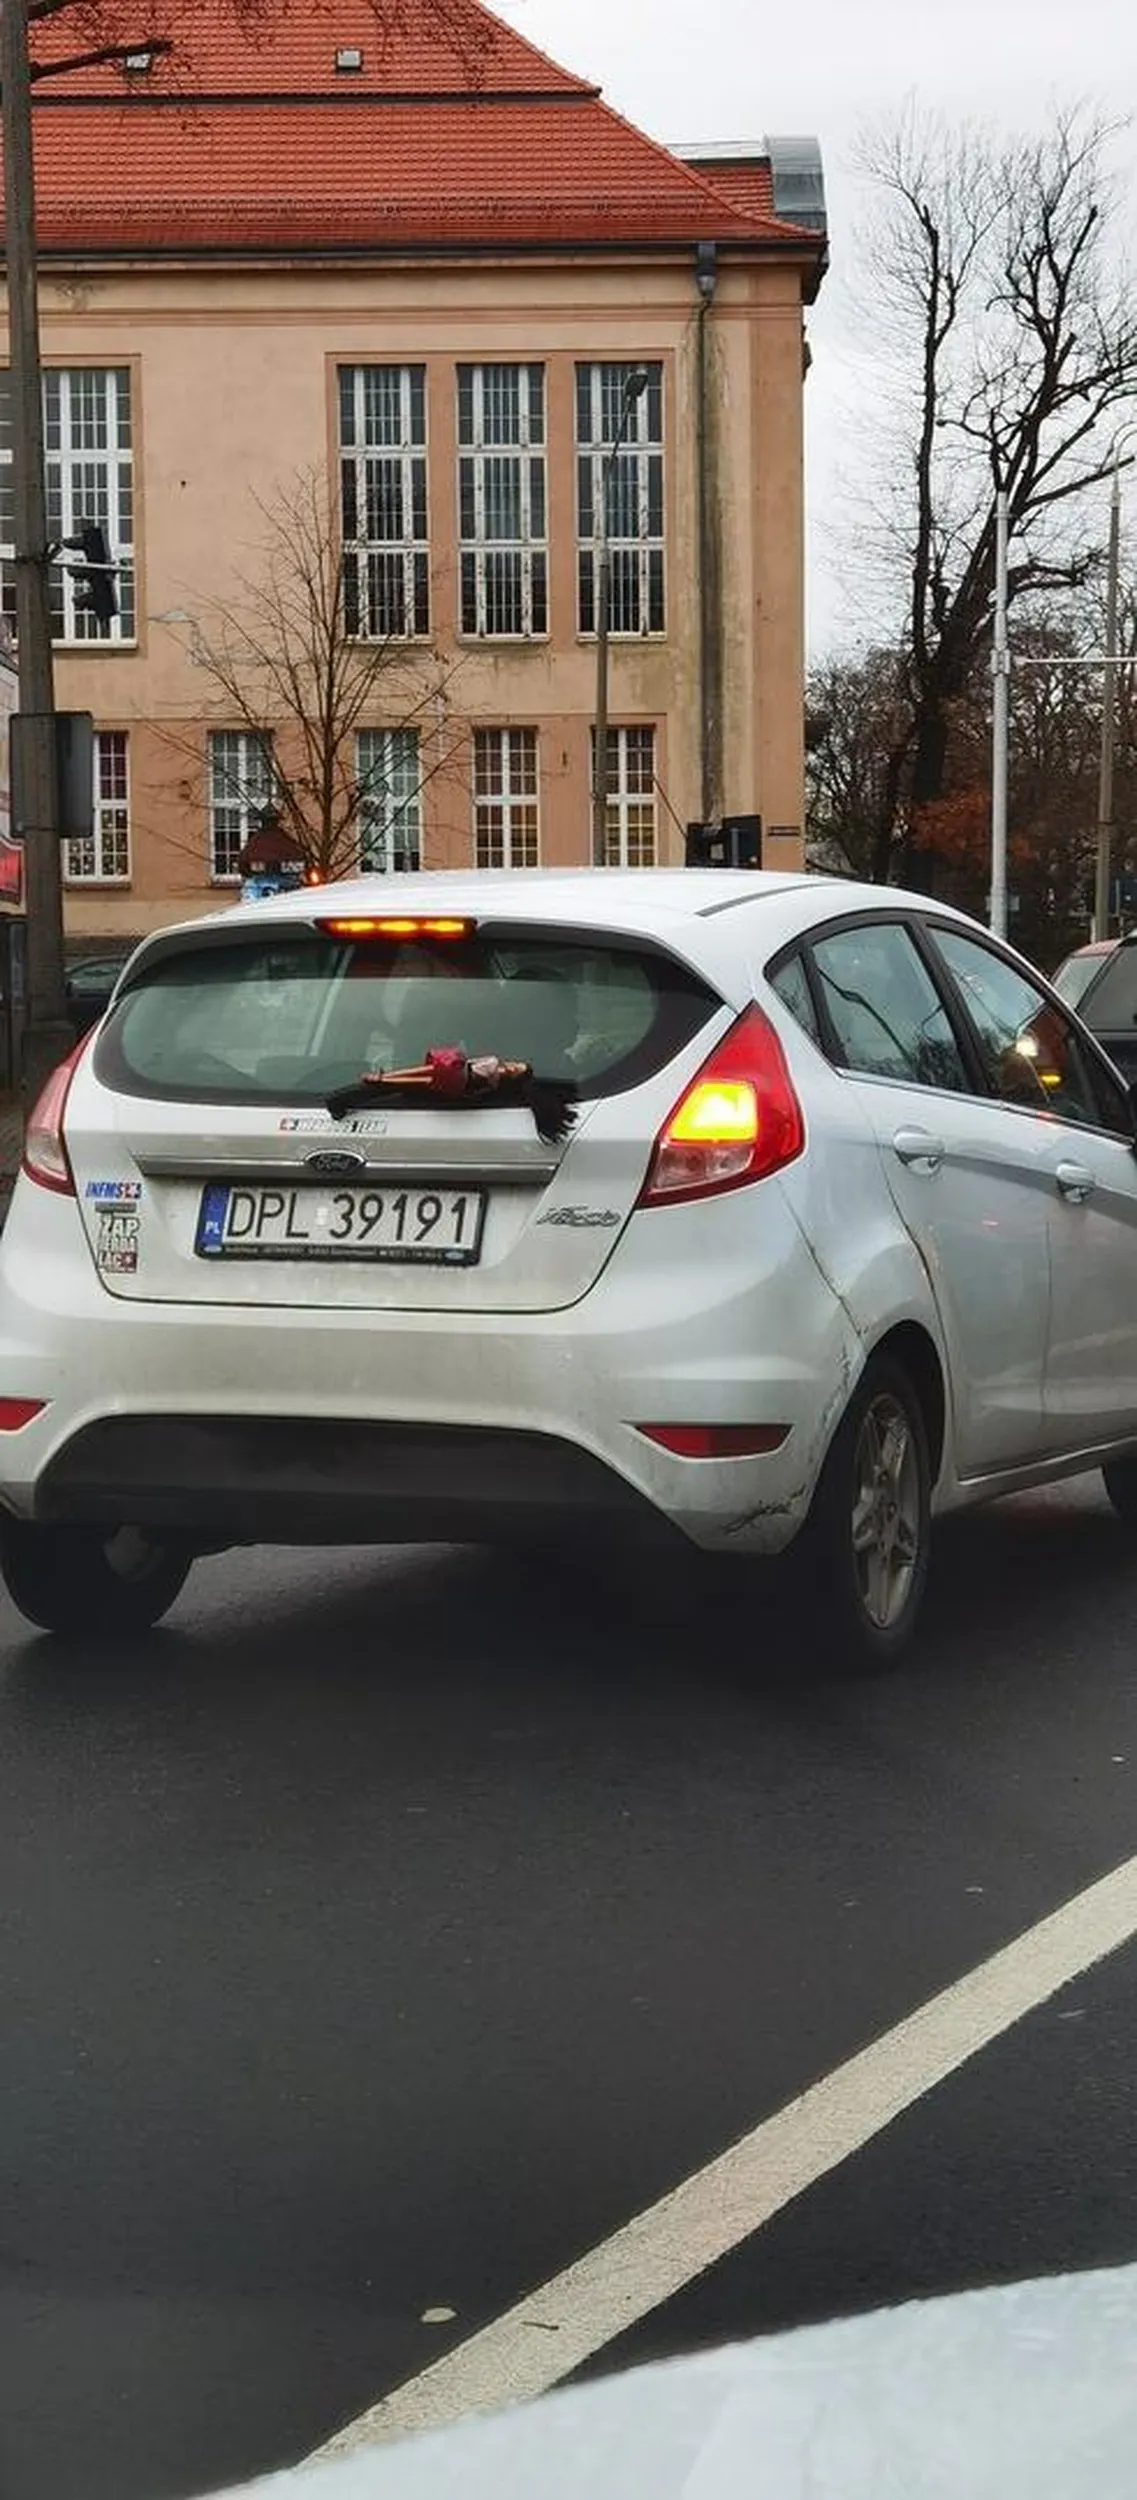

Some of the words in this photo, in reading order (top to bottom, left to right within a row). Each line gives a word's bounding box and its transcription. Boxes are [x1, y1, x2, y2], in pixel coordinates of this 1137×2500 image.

[205, 1220, 221, 1235] PL
[226, 1191, 309, 1239] DPL
[329, 1193, 467, 1243] 39191
